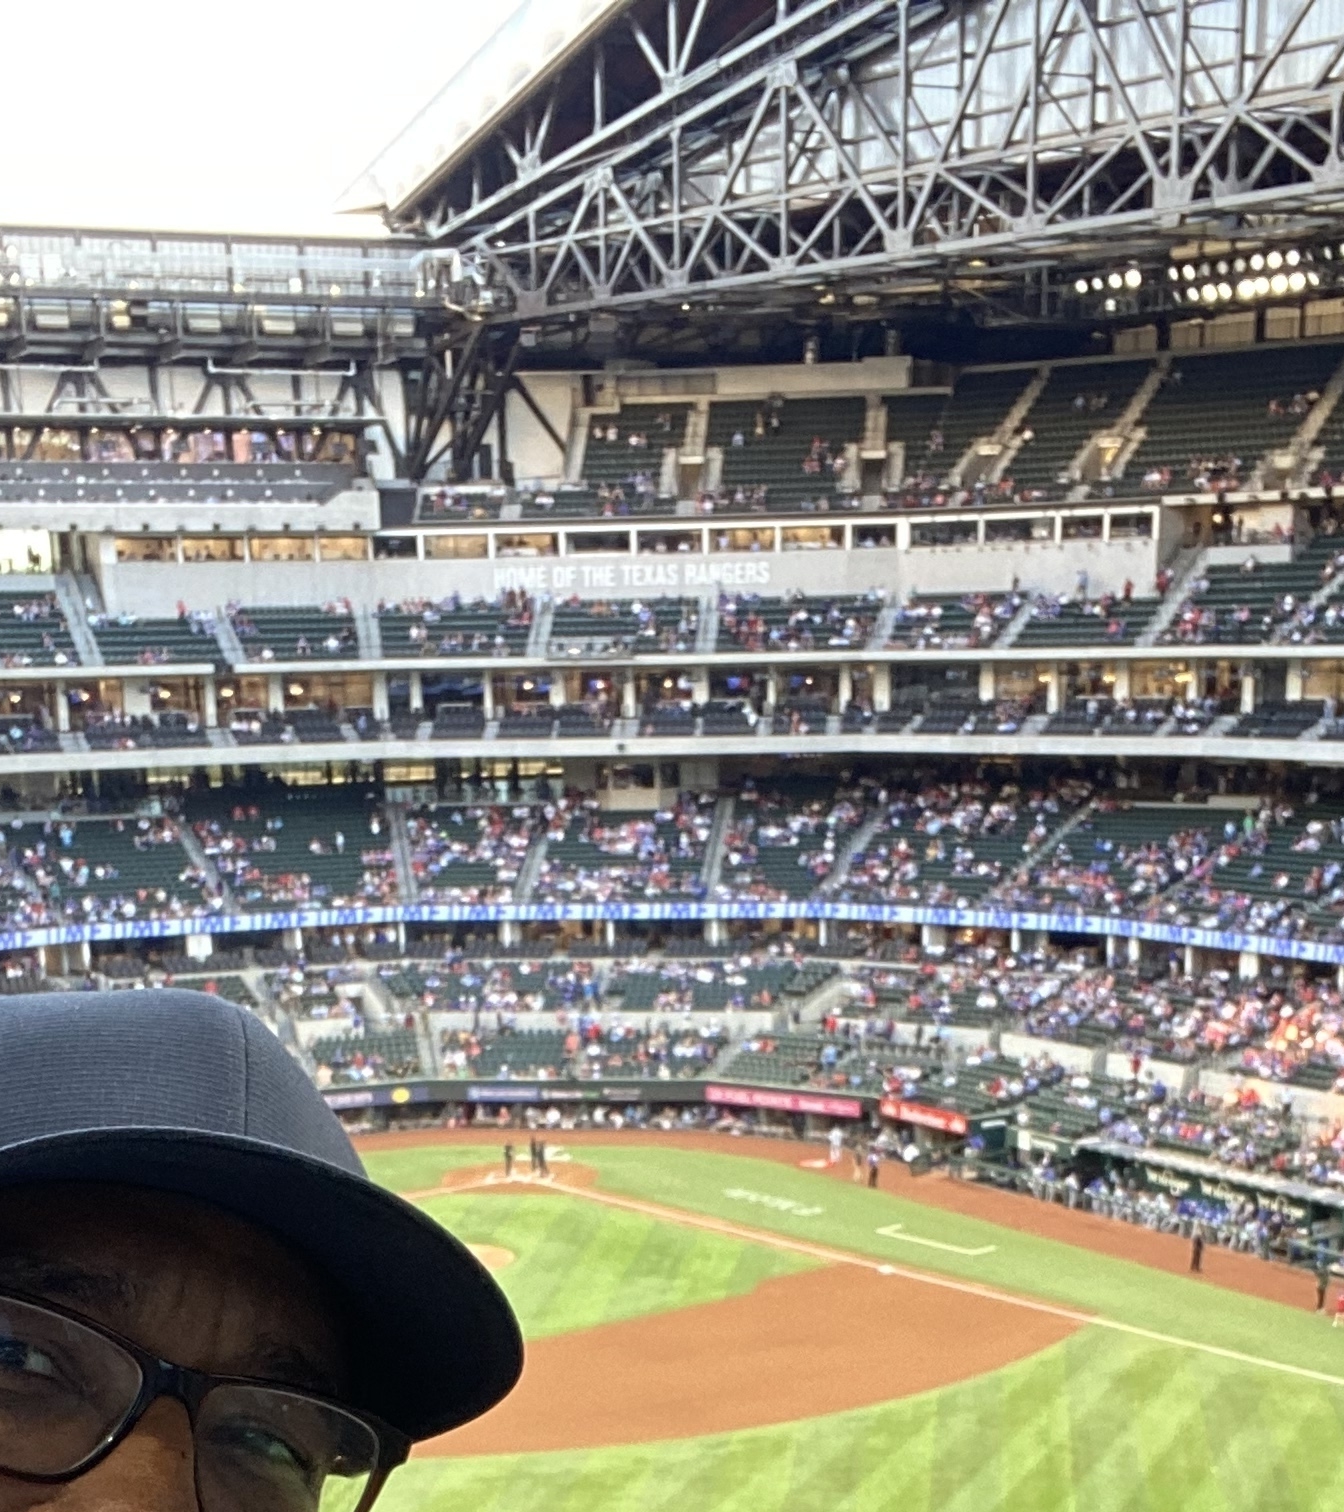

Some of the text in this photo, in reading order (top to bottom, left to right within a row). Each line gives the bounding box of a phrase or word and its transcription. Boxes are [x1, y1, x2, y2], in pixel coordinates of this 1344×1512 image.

[493, 561, 771, 588] HOME OF THE TEXAS RANGERS
